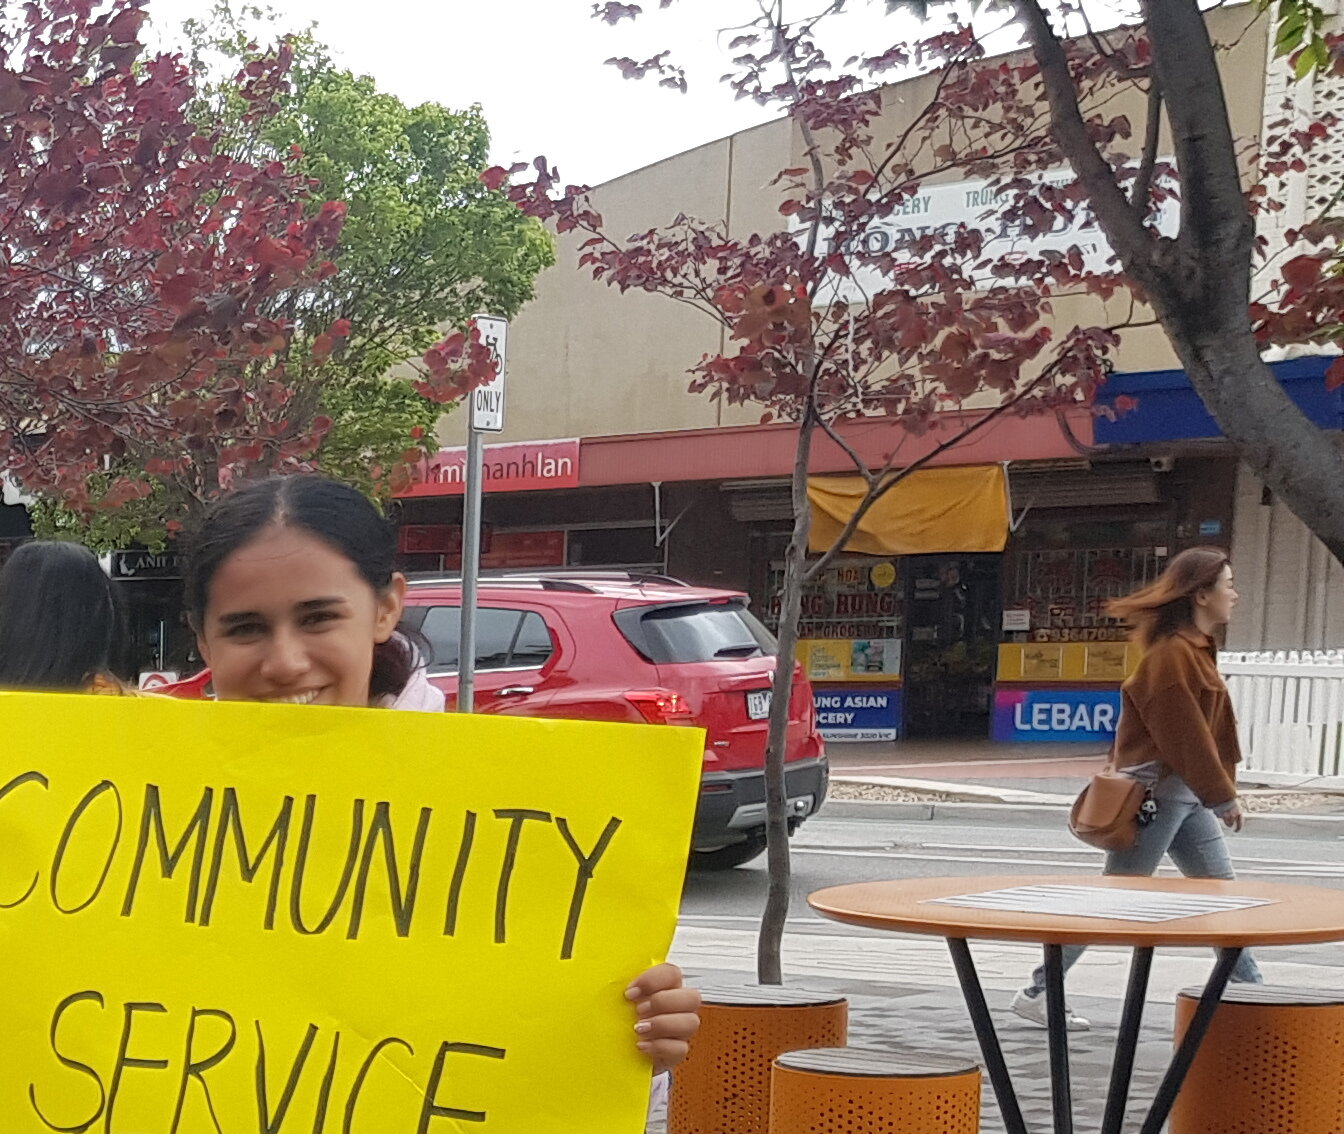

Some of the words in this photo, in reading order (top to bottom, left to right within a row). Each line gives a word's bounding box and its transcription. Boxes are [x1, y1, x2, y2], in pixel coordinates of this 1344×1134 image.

[476, 389, 502, 414] ONLY
[813, 696, 841, 708] UNG
[844, 696, 888, 708] ASIAN
[815, 712, 855, 724] CERY
[1014, 702, 1118, 732] LEBAR
